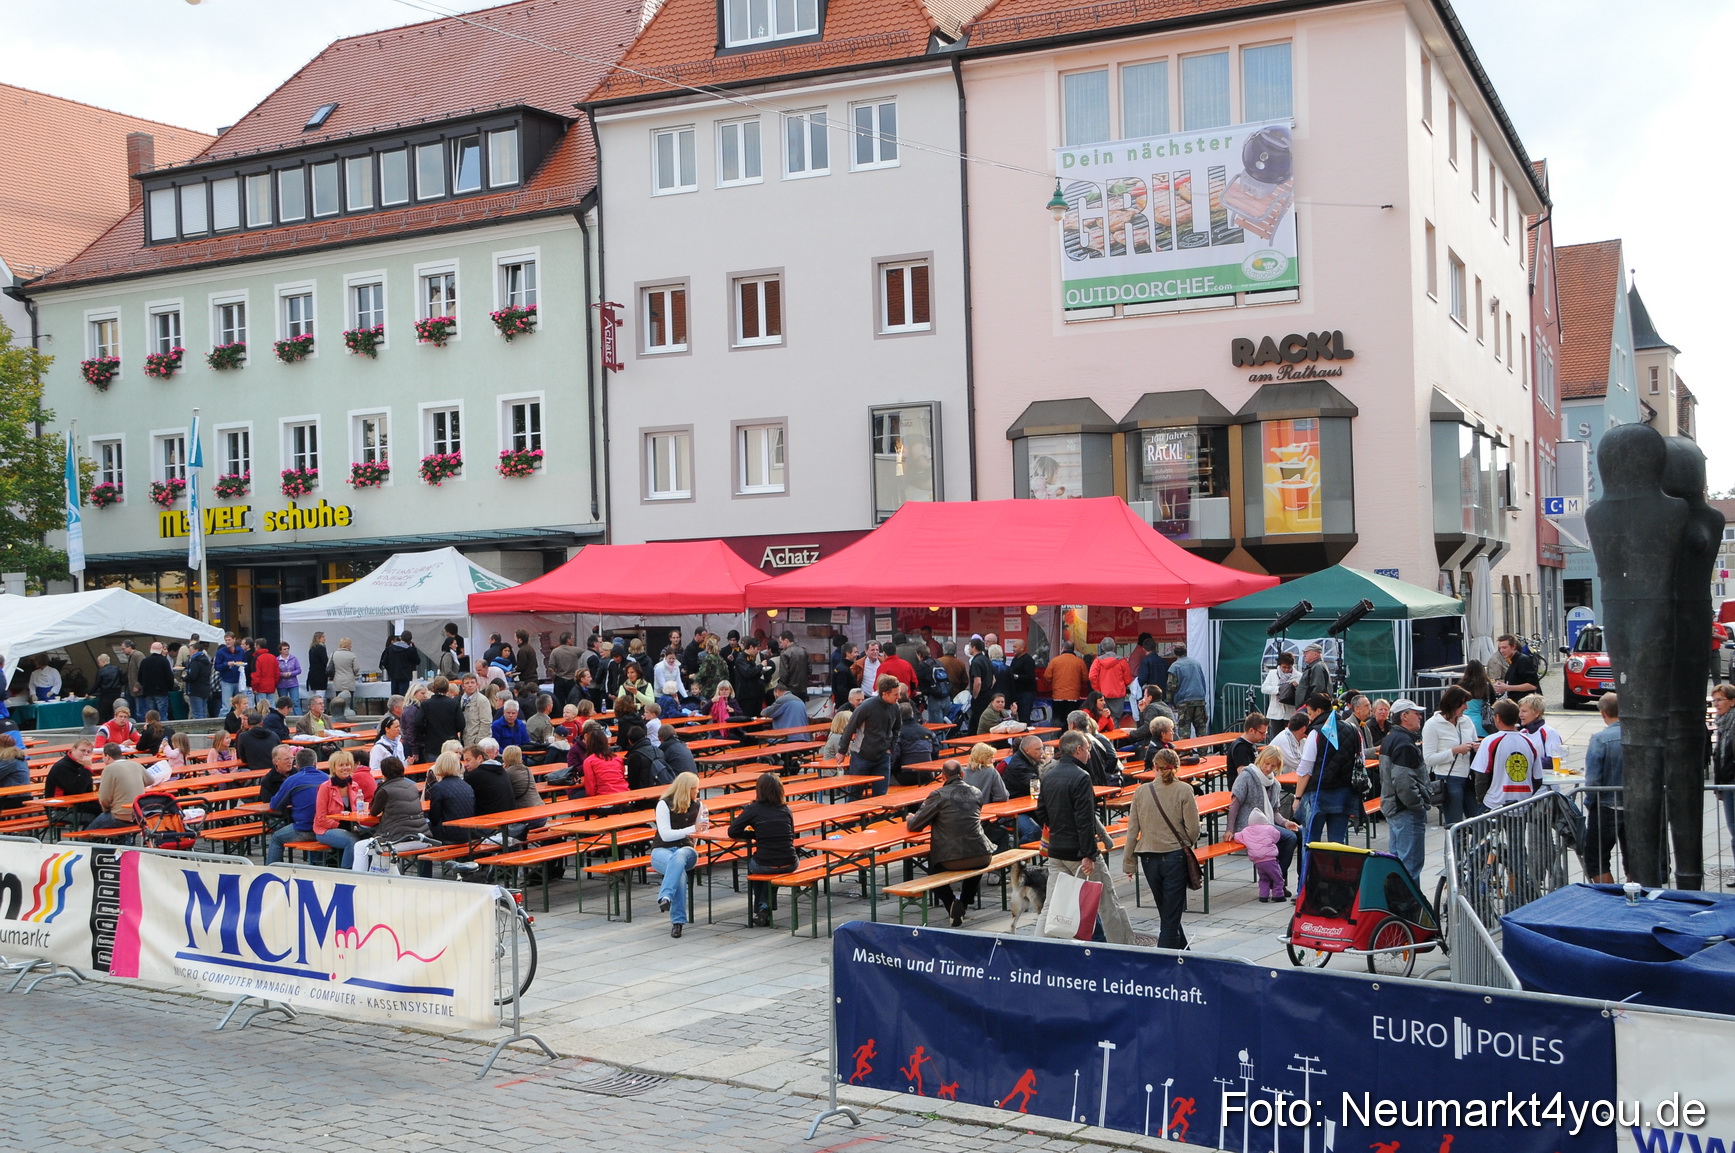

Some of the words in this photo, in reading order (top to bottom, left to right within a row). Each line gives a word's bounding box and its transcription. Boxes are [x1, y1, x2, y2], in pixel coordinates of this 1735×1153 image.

[1062, 149, 1114, 169] Dein
[1127, 136, 1233, 162] nächster
[1063, 165, 1245, 262] GRILL
[604, 316, 614, 364] Achatz
[1231, 330, 1354, 368] RACKL
[1248, 371, 1273, 383] am
[1276, 364, 1343, 381] Rathaus
[1147, 443, 1183, 462] RACKL
[1166, 431, 1189, 442] Jahre
[263, 499, 353, 532] schuhe
[760, 546, 820, 568] Achatz
[181, 869, 357, 965] MCM
[0, 928, 50, 948] umarkt
[174, 966, 199, 980] MICRO
[202, 971, 253, 988] COMPUTER
[255, 979, 301, 996] MANAGING
[310, 987, 356, 1005] COMPUTER
[367, 997, 455, 1017] KASSENSYSTEME
[853, 948, 902, 970] Masten
[907, 958, 934, 973] und
[939, 959, 985, 979] Türme
[1009, 968, 1041, 985] sind
[1047, 975, 1097, 992] unsere
[1103, 977, 1208, 1006] Leidenschaft.
[1373, 1016, 1448, 1048] EURO
[1478, 1029, 1564, 1065] POLES
